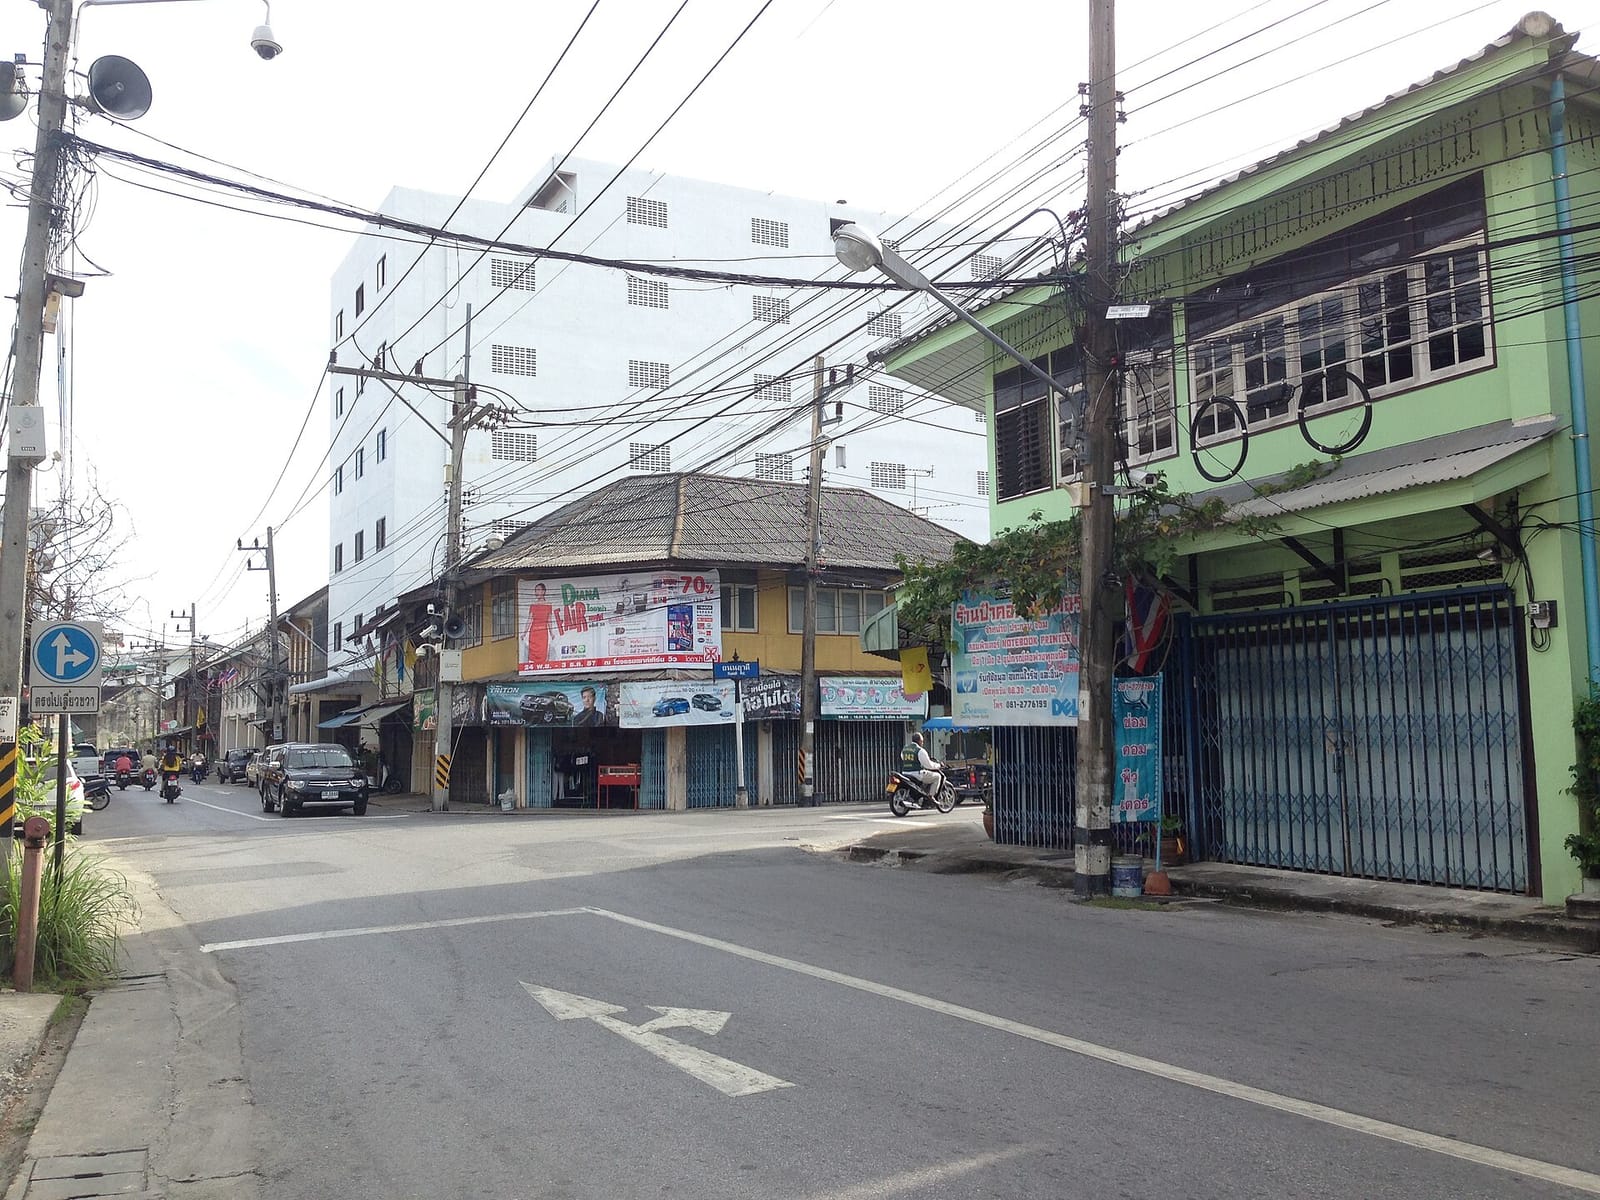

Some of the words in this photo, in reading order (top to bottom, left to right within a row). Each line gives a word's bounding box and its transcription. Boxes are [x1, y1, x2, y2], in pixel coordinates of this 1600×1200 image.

[680, 575, 714, 595] 70%
[1002, 636, 1039, 647] NOTEBOOK
[1032, 684, 1049, 694] 20.00
[34, 689, 95, 710] ตรงไปเลี้ยวขวา
[1123, 712, 1147, 728] ซ่อม
[1122, 745, 1147, 756] คอม
[1121, 768, 1138, 783] พิว
[1120, 793, 1149, 810] เตอร์
